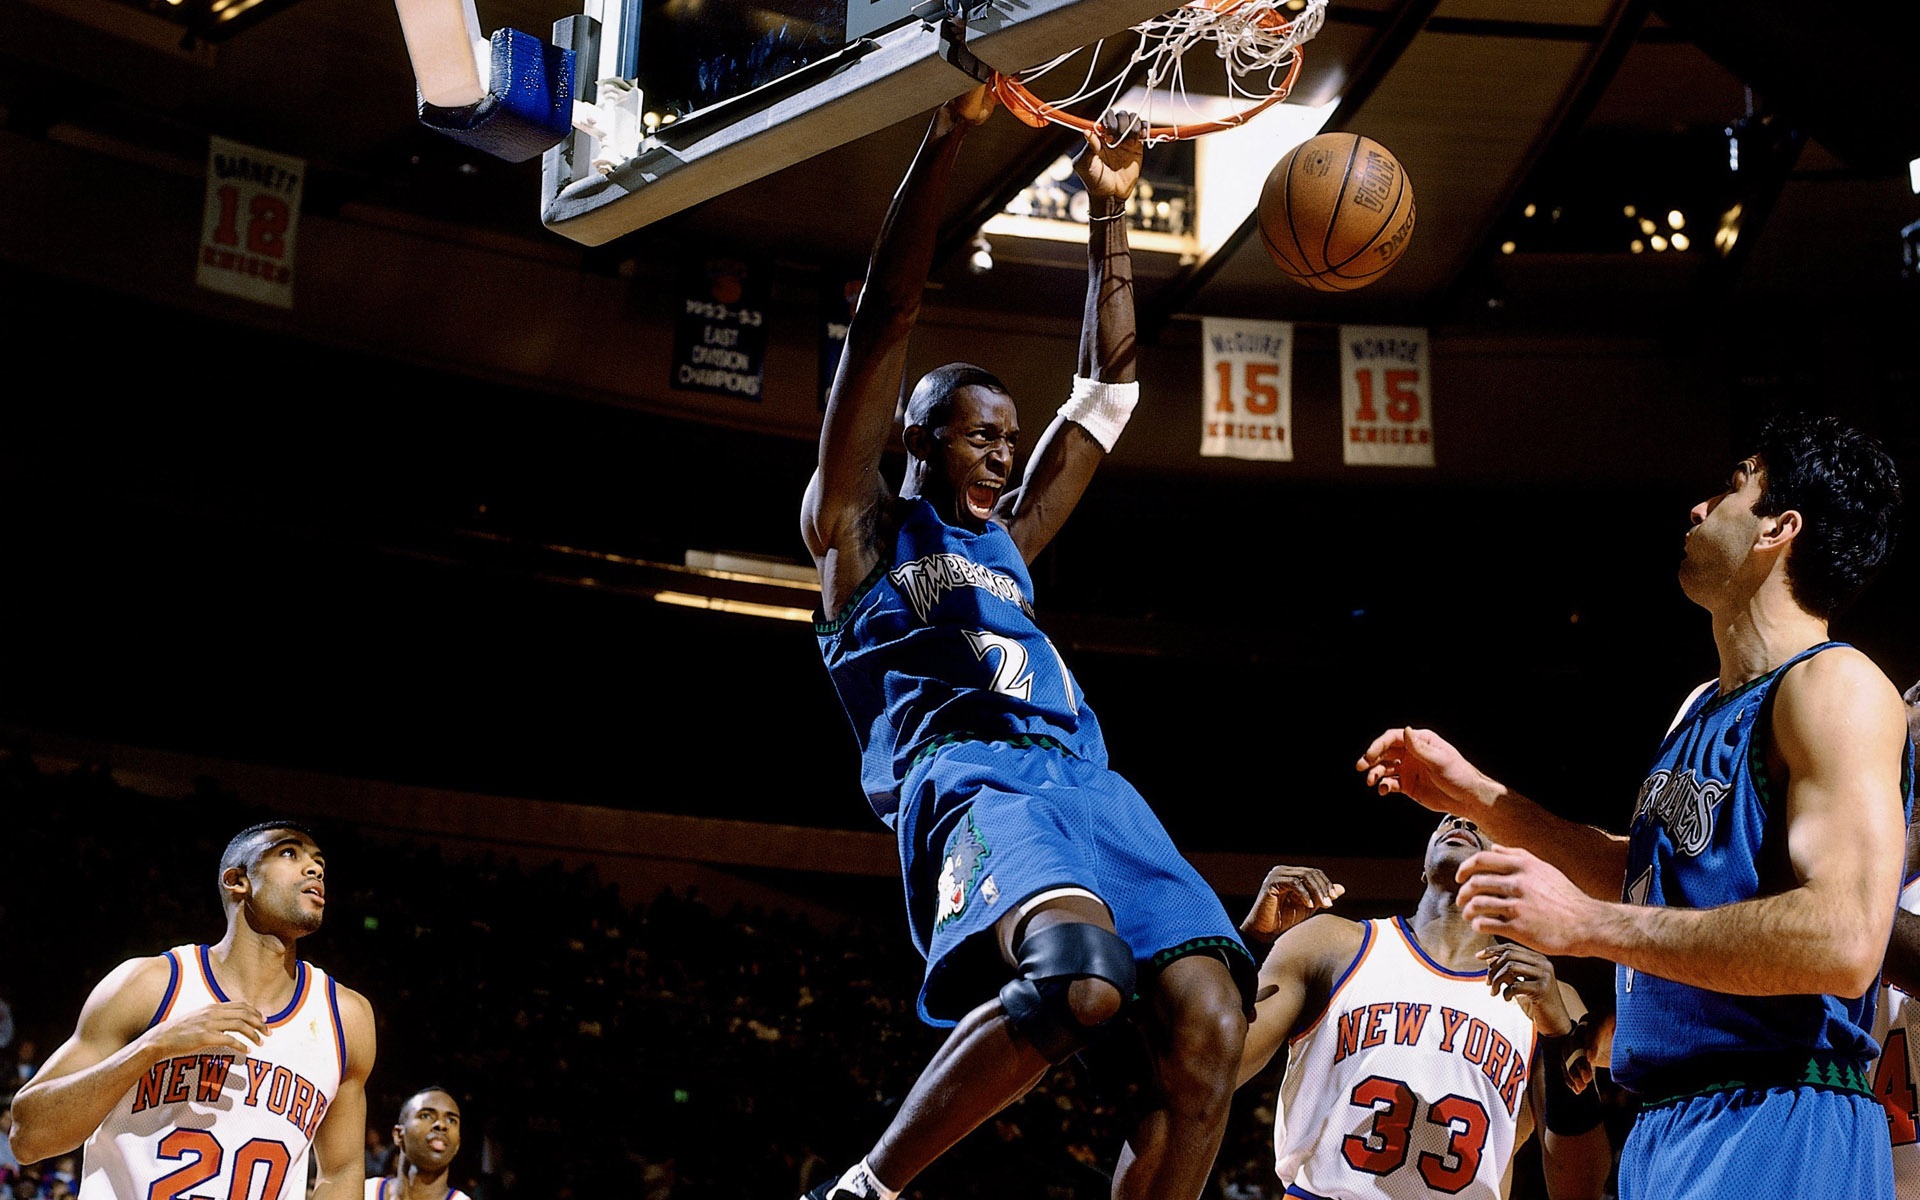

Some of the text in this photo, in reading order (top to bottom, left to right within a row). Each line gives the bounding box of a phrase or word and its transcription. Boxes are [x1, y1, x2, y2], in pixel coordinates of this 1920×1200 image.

[1352, 338, 1418, 363] MONROE
[1216, 362, 1279, 415] 15
[1356, 368, 1421, 422] 15
[1208, 423, 1285, 441] KNICKS
[1350, 427, 1429, 445] KNICKS
[131, 1054, 235, 1115] NEW
[1334, 1001, 1527, 1118] NEW YORK
[1340, 1075, 1490, 1195] 33
[148, 1127, 292, 1200] 20
